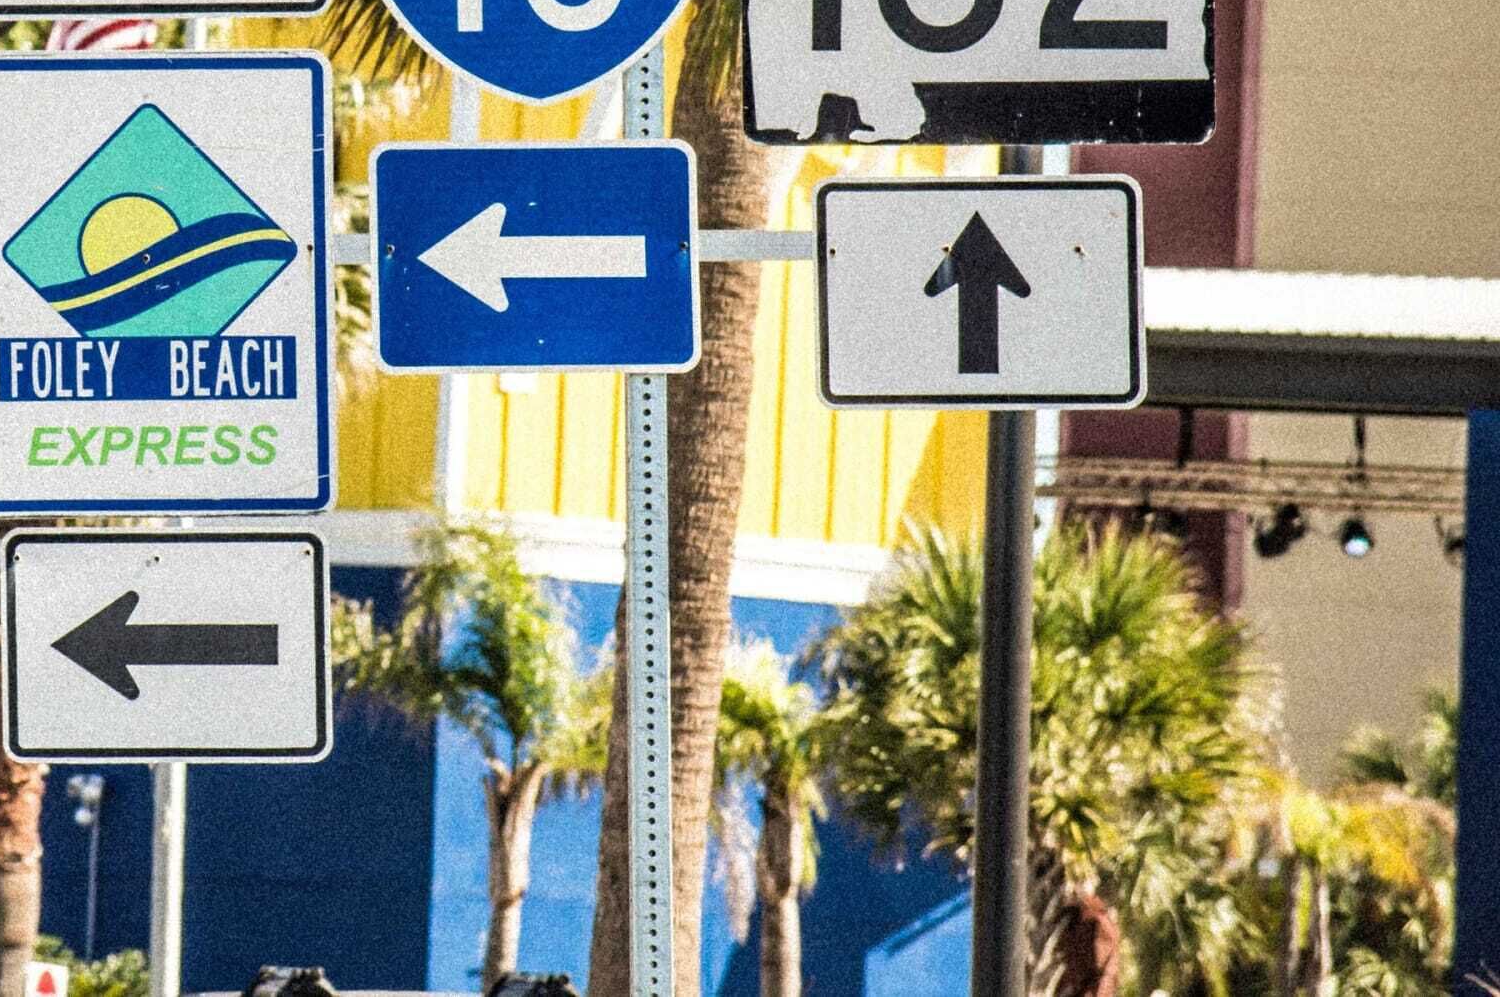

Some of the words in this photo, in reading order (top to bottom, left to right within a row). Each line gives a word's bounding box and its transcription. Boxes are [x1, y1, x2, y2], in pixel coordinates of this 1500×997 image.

[10, 340, 120, 399] FOLEY
[169, 338, 285, 397] BEACH
[27, 425, 278, 466] EXPRESS
